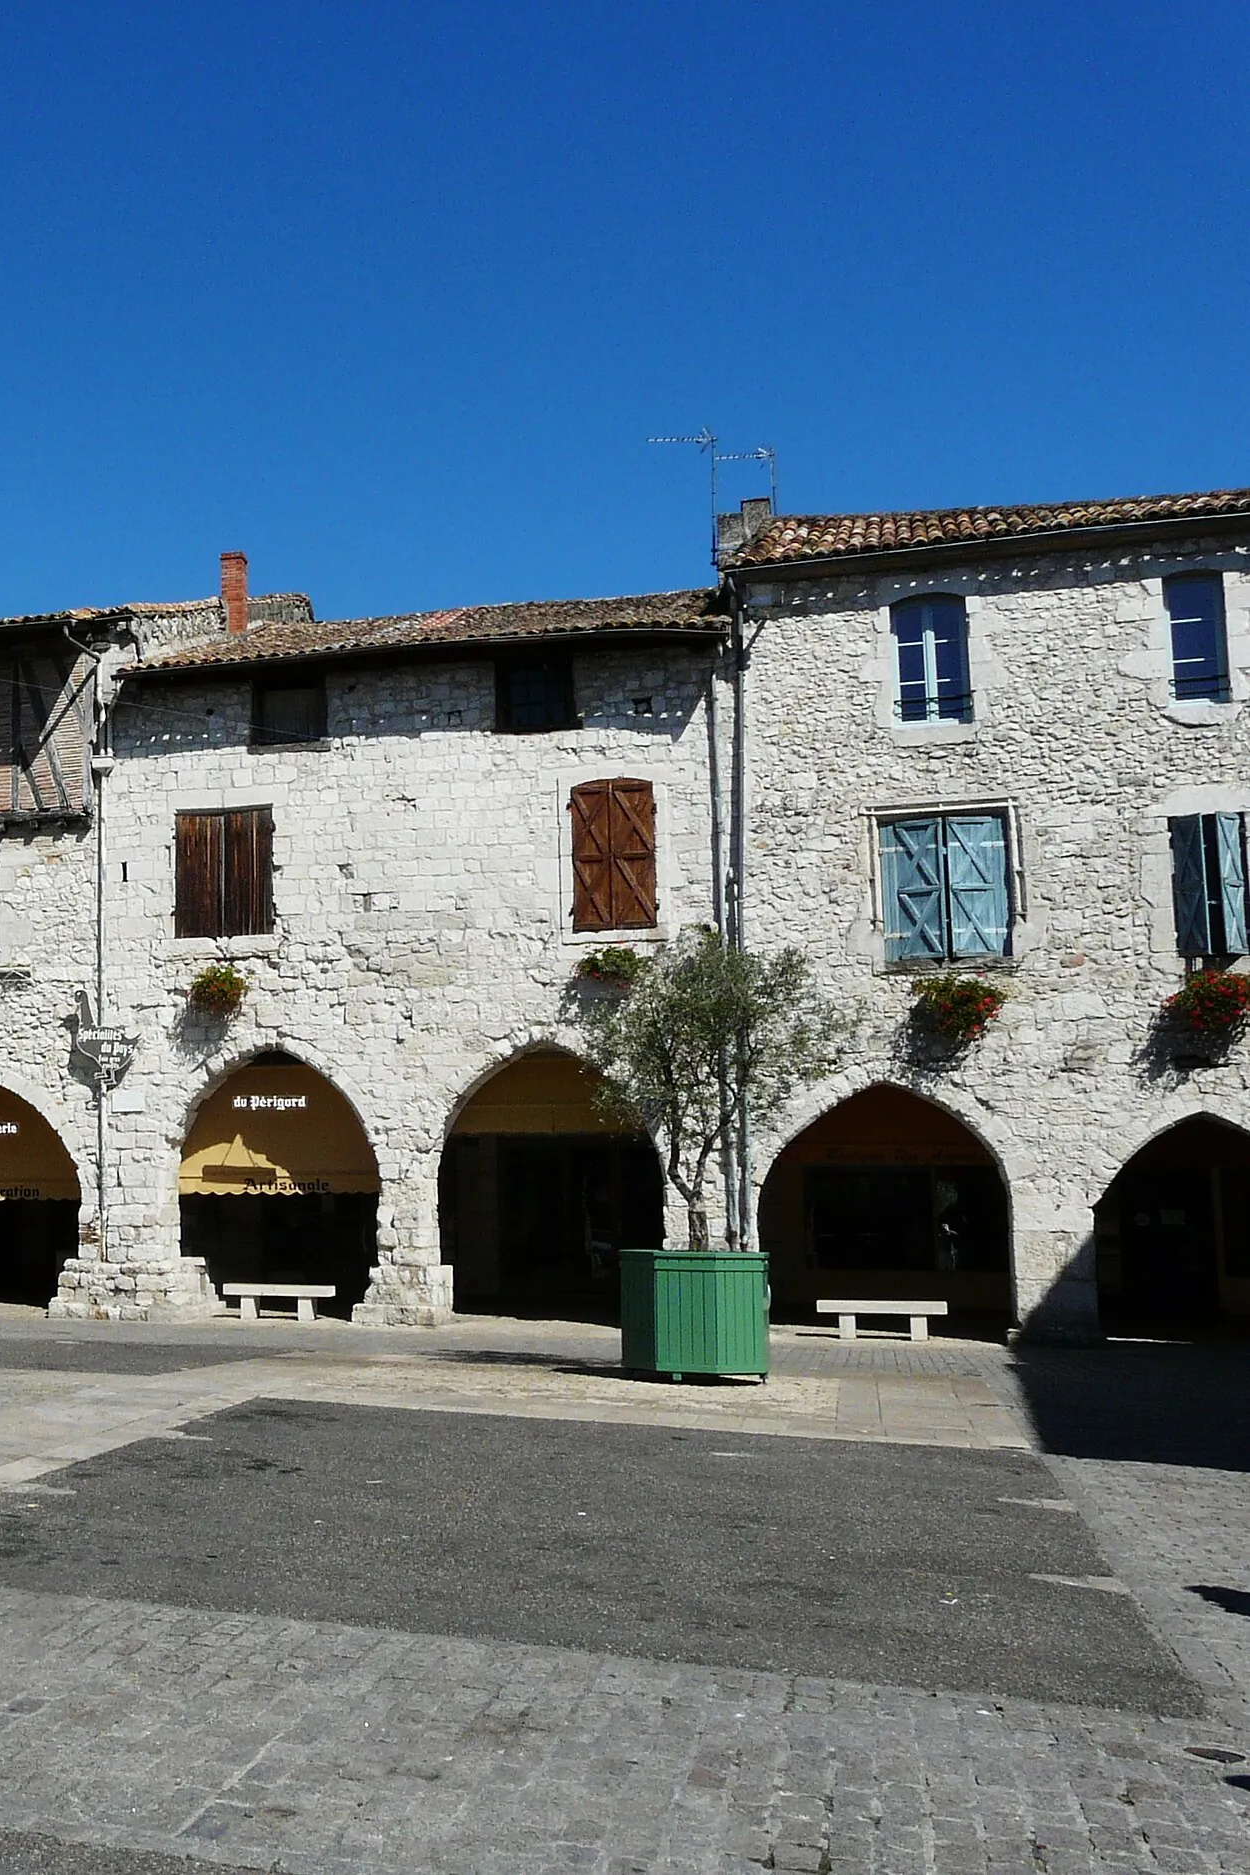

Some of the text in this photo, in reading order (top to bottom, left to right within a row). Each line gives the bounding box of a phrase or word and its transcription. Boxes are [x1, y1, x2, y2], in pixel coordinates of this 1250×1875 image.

[101, 1041, 112, 1053] du
[233, 1095, 307, 1111] du Périgord
[243, 1177, 330, 1192] Artisanale
